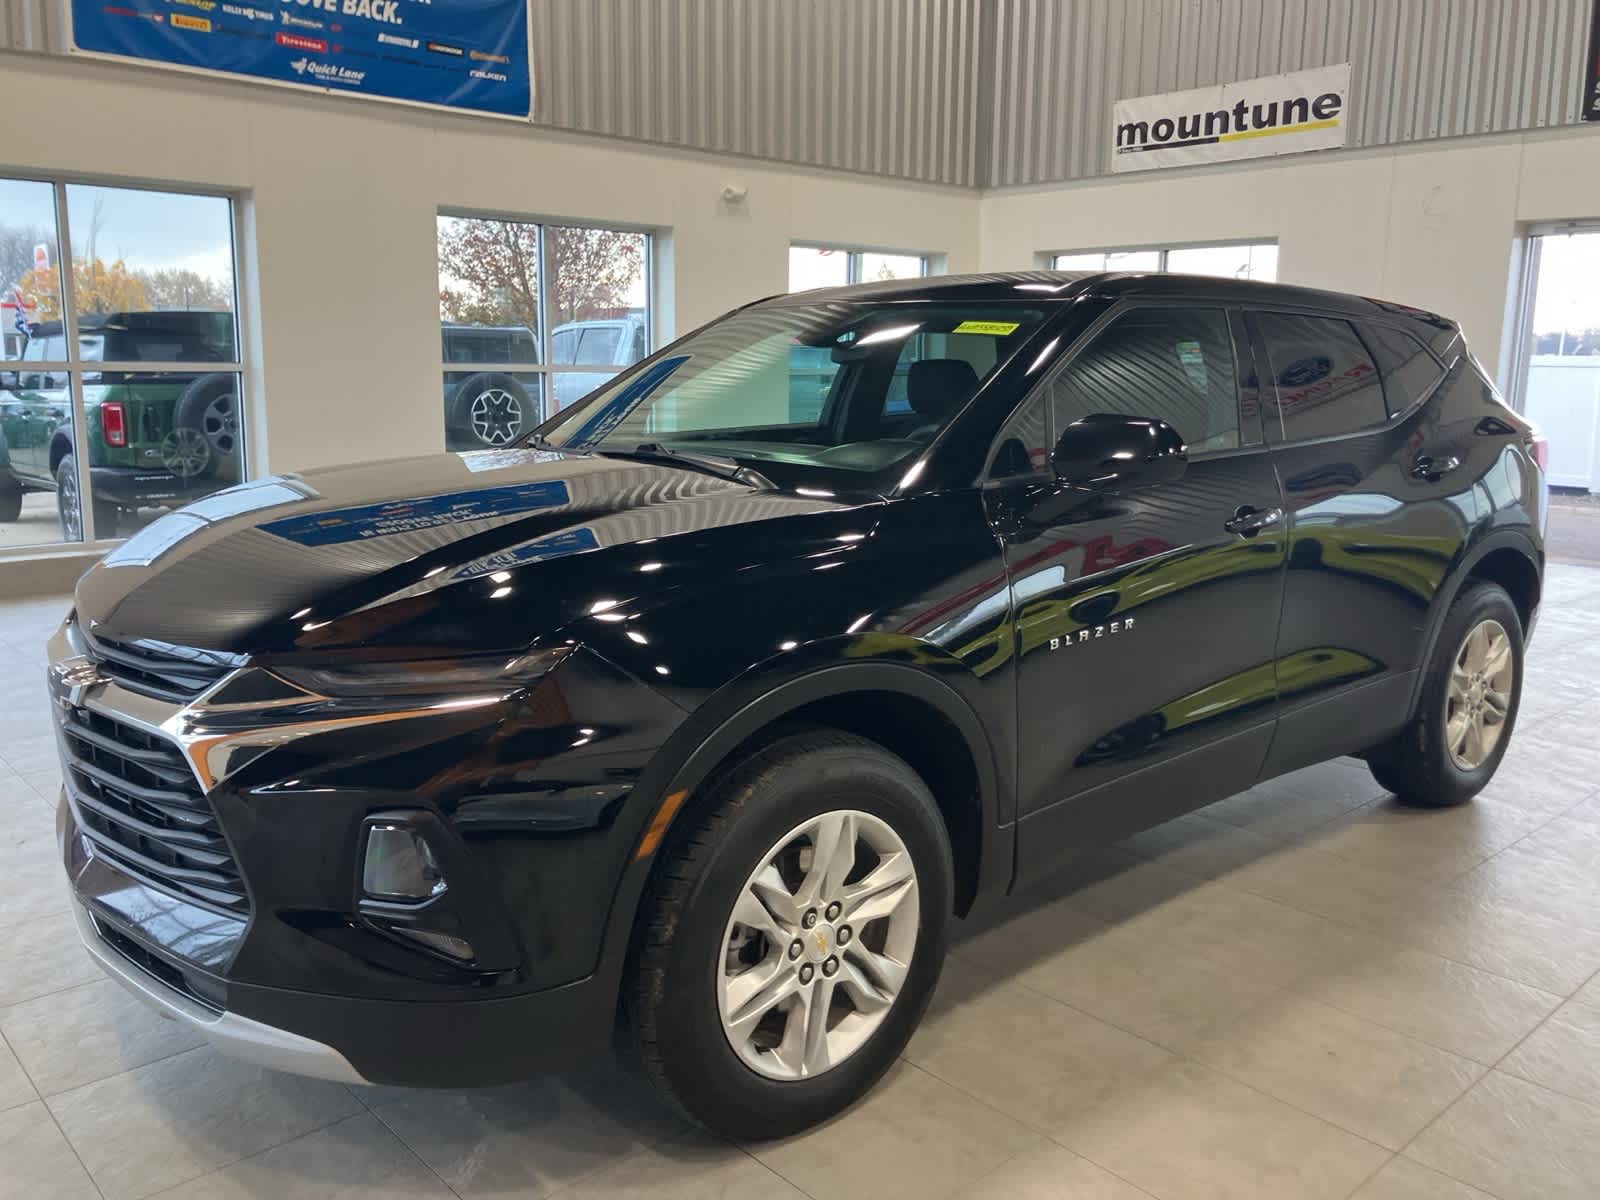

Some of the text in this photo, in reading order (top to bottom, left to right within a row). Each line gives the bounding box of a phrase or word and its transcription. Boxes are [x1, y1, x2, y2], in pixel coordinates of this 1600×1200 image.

[307, 61, 338, 76] Quick
[338, 66, 366, 80] Lane
[1117, 93, 1342, 146] mountune
[1050, 618, 1135, 650] BLAZER
